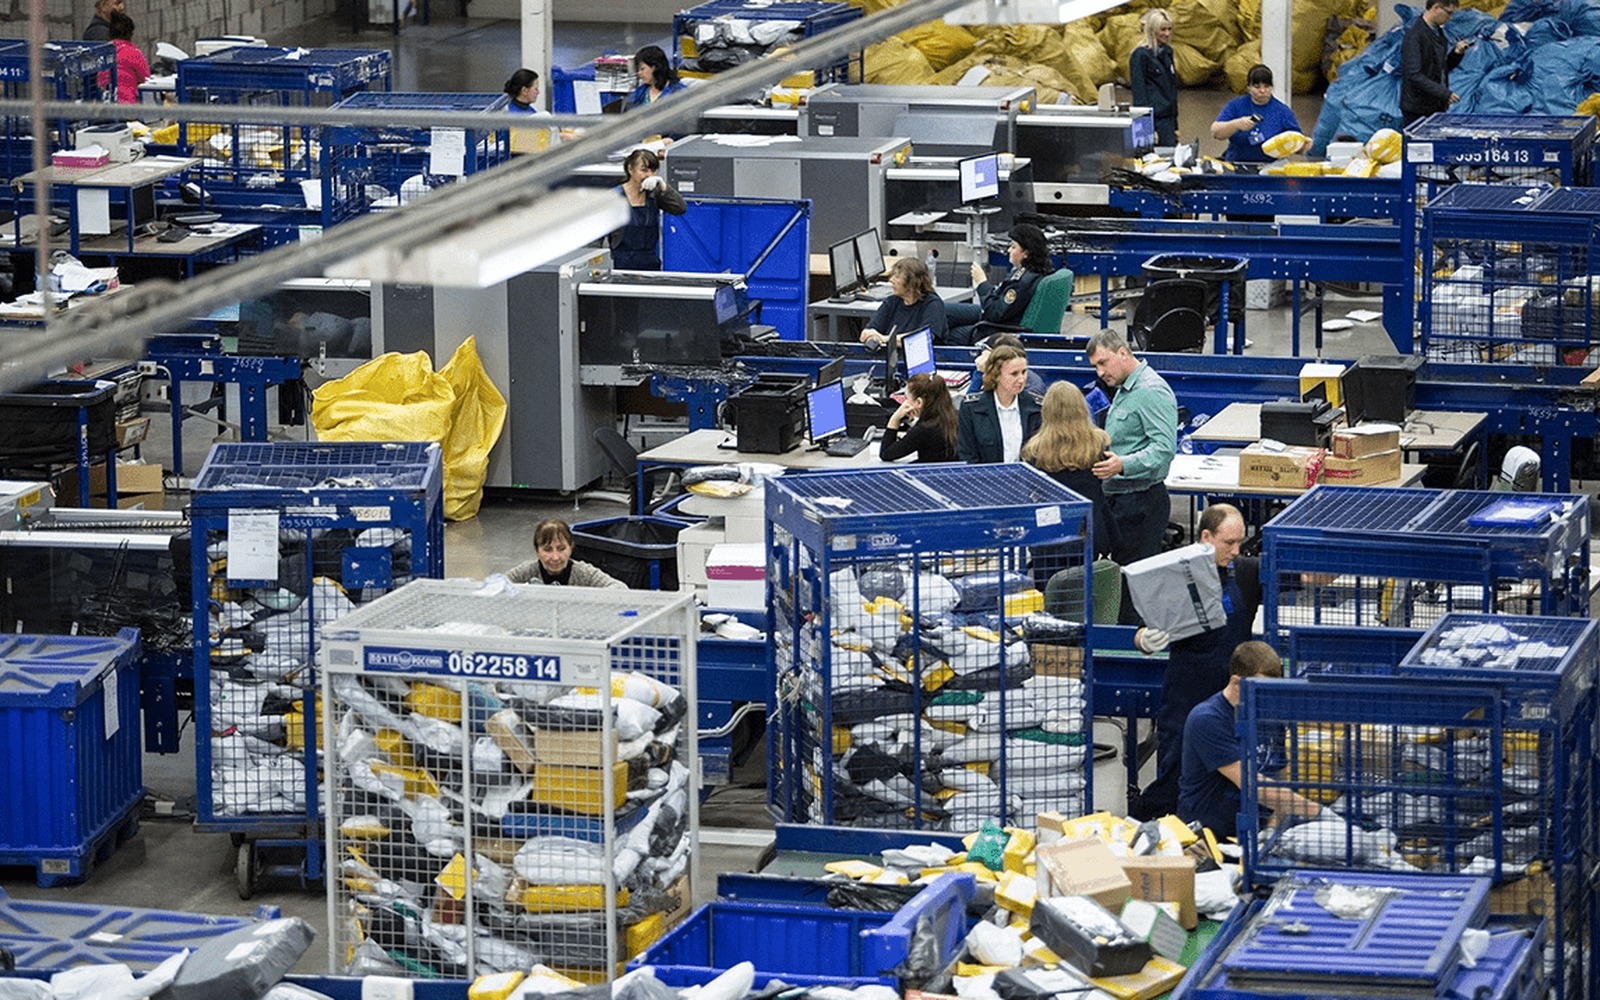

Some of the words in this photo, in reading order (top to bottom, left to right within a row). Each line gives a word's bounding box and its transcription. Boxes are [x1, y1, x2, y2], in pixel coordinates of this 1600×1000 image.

[1513, 149, 1529, 163] 13
[448, 653, 528, 677] 062258
[533, 658, 558, 678] 14
